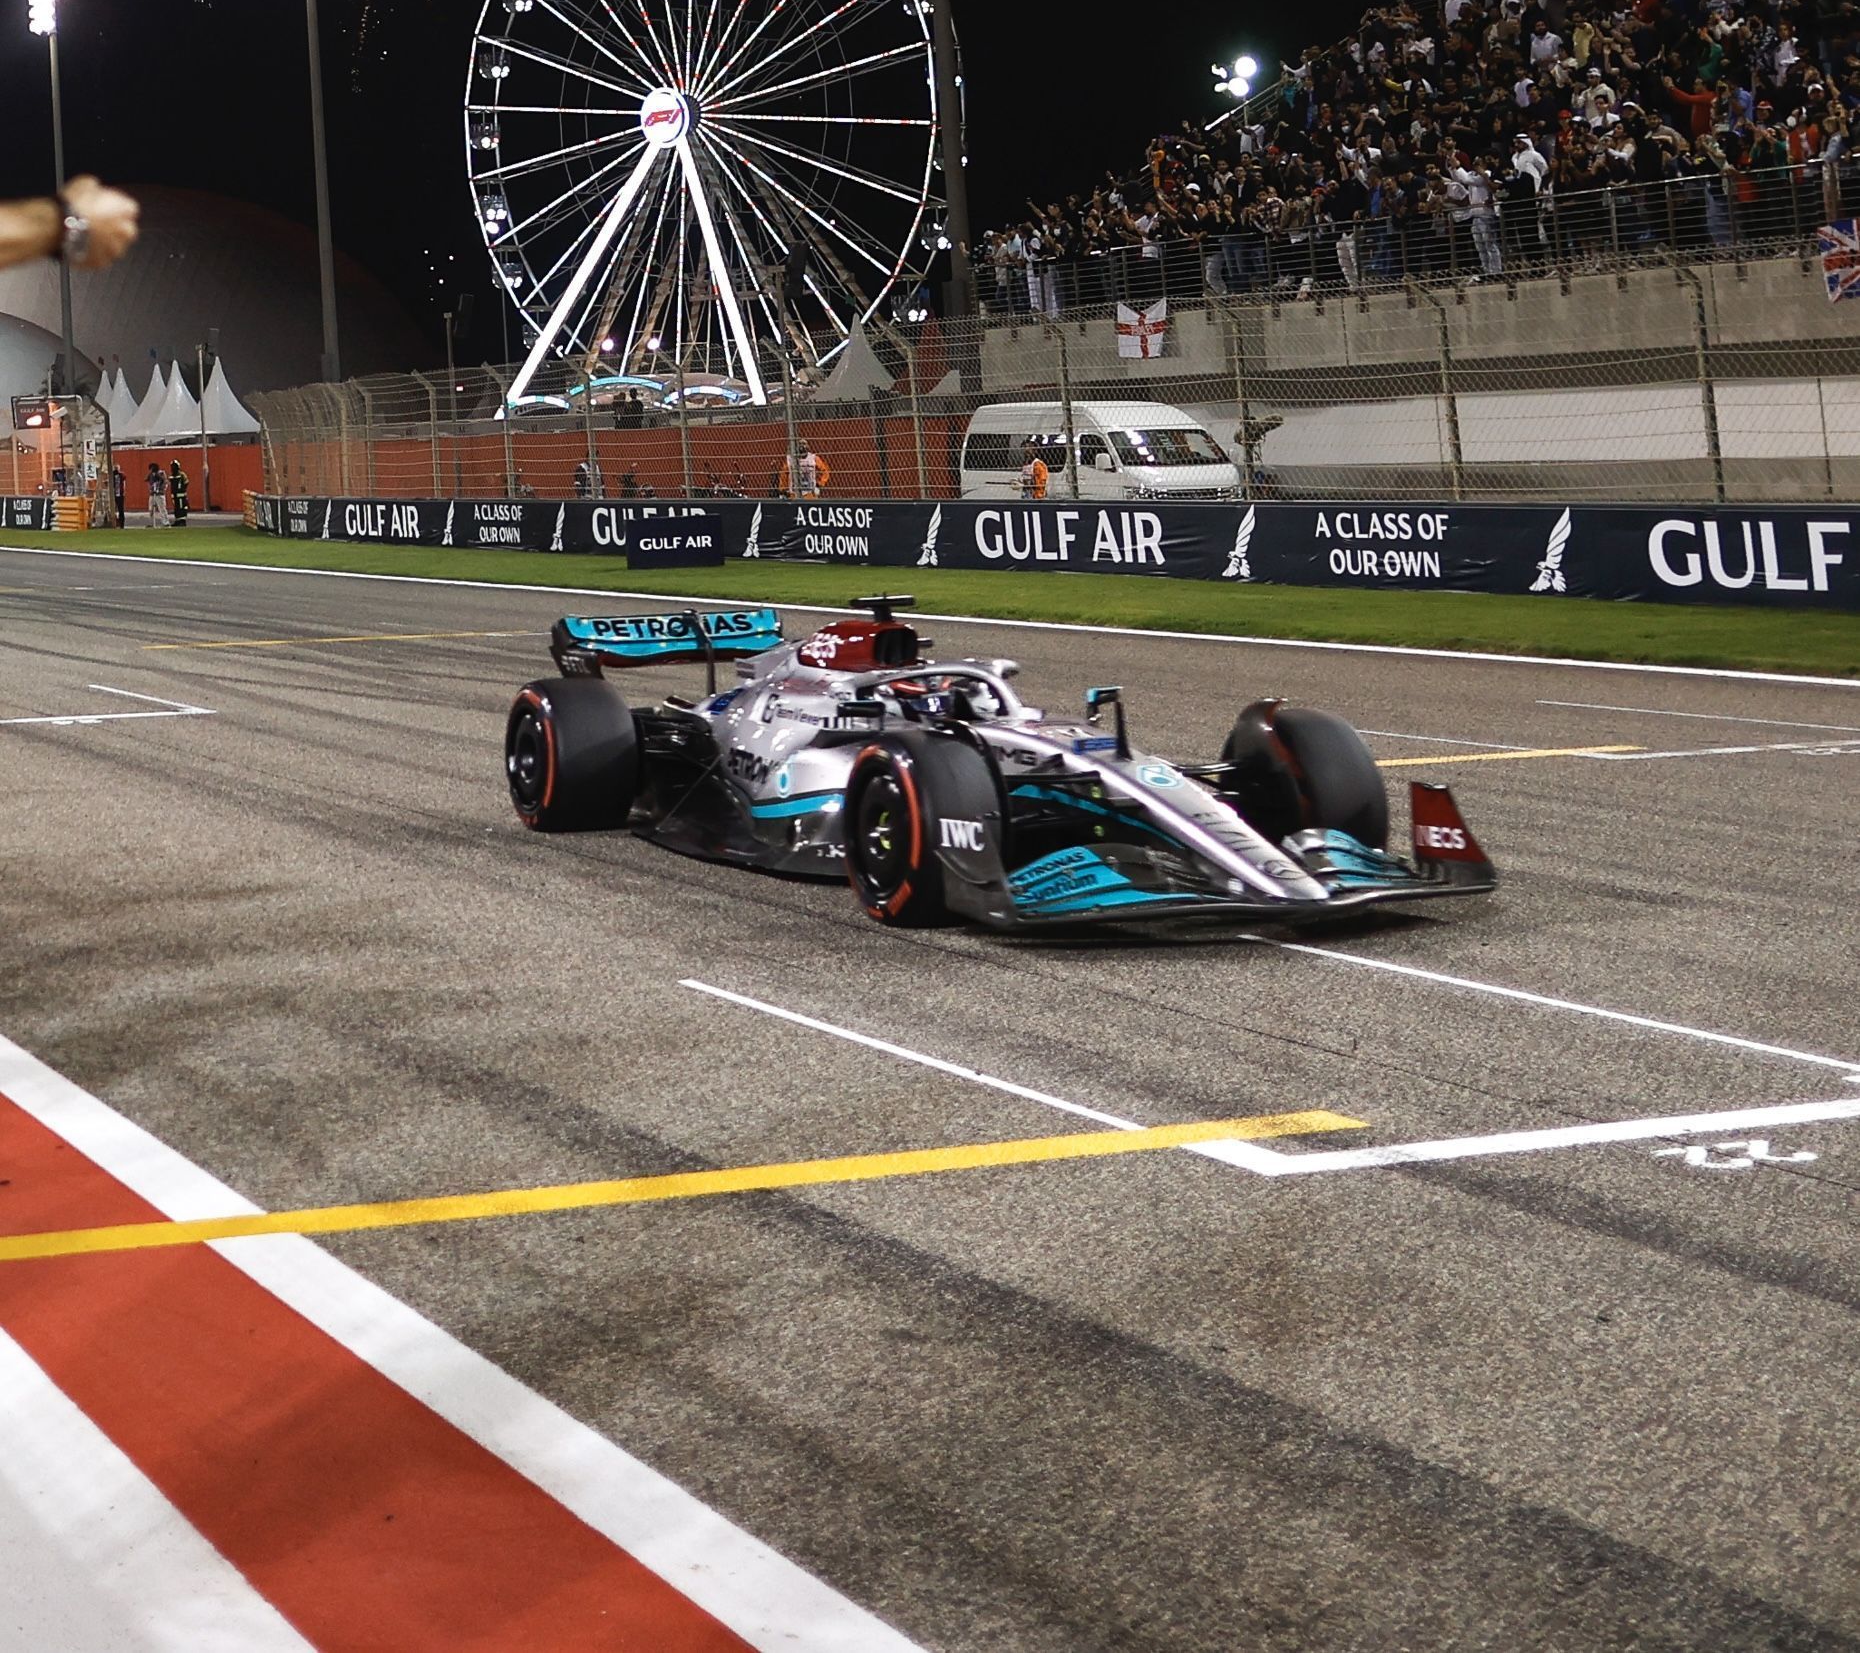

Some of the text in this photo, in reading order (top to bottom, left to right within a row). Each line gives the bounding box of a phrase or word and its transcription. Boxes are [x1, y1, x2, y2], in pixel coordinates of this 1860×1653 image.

[346, 504, 420, 538] GULF AIR
[474, 504, 523, 522] A CLASS OF
[796, 506, 874, 529] A CLASS OF
[479, 526, 521, 544] OUR OWN
[974, 510, 1166, 565] GULF AIR
[1315, 512, 1449, 541] A CLASS OF
[639, 535, 713, 551] GULF AIR
[805, 534, 869, 557] OUR OWN
[1648, 519, 1850, 592] GULF
[1329, 548, 1441, 578] OUR OWN
[592, 613, 752, 639] PETROAS
[939, 818, 984, 852] IWC
[1415, 825, 1466, 849] NEOS
